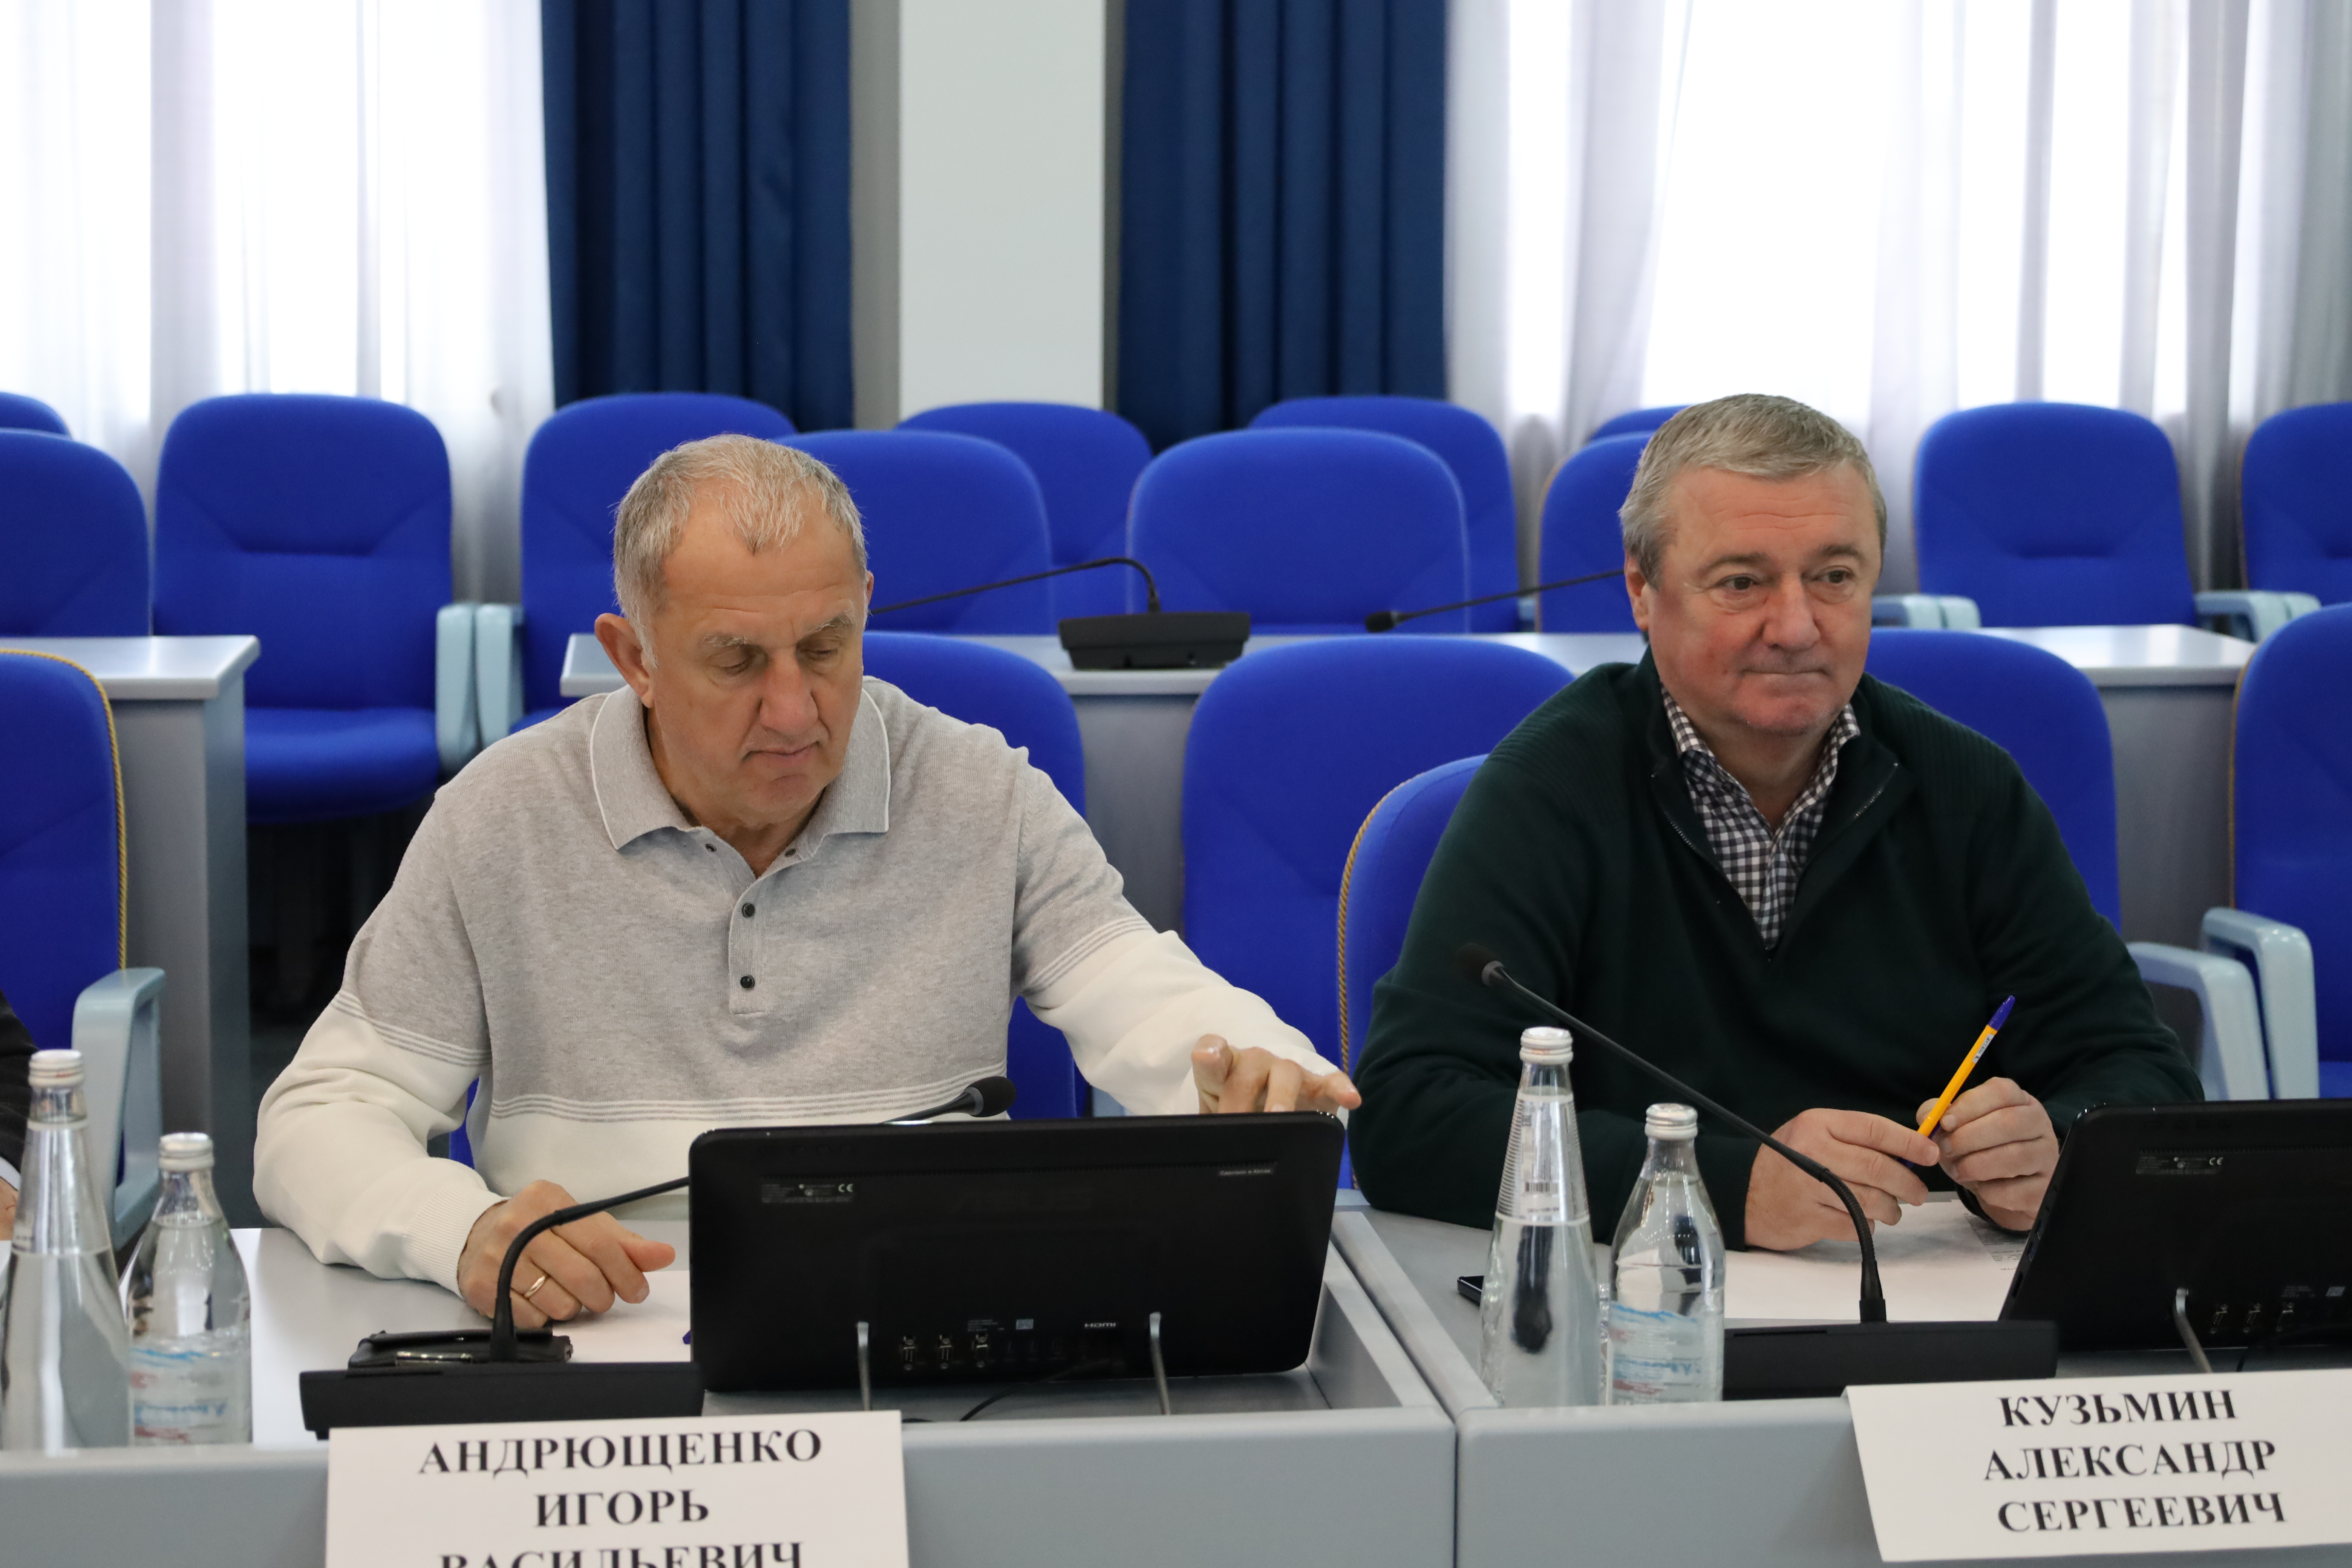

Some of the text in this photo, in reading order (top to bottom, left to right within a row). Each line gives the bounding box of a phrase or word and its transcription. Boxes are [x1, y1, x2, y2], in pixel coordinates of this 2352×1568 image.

[1998, 1389, 2238, 1427] КУЗЬМИН
[418, 1429, 822, 1478] АНДРЮЩЕНКО
[1983, 1440, 2276, 1480] АЛЕКСАНДР
[534, 1489, 710, 1528] ИГОРЬ
[1997, 1492, 2287, 1533] СЕРГЕЕВИЧ
